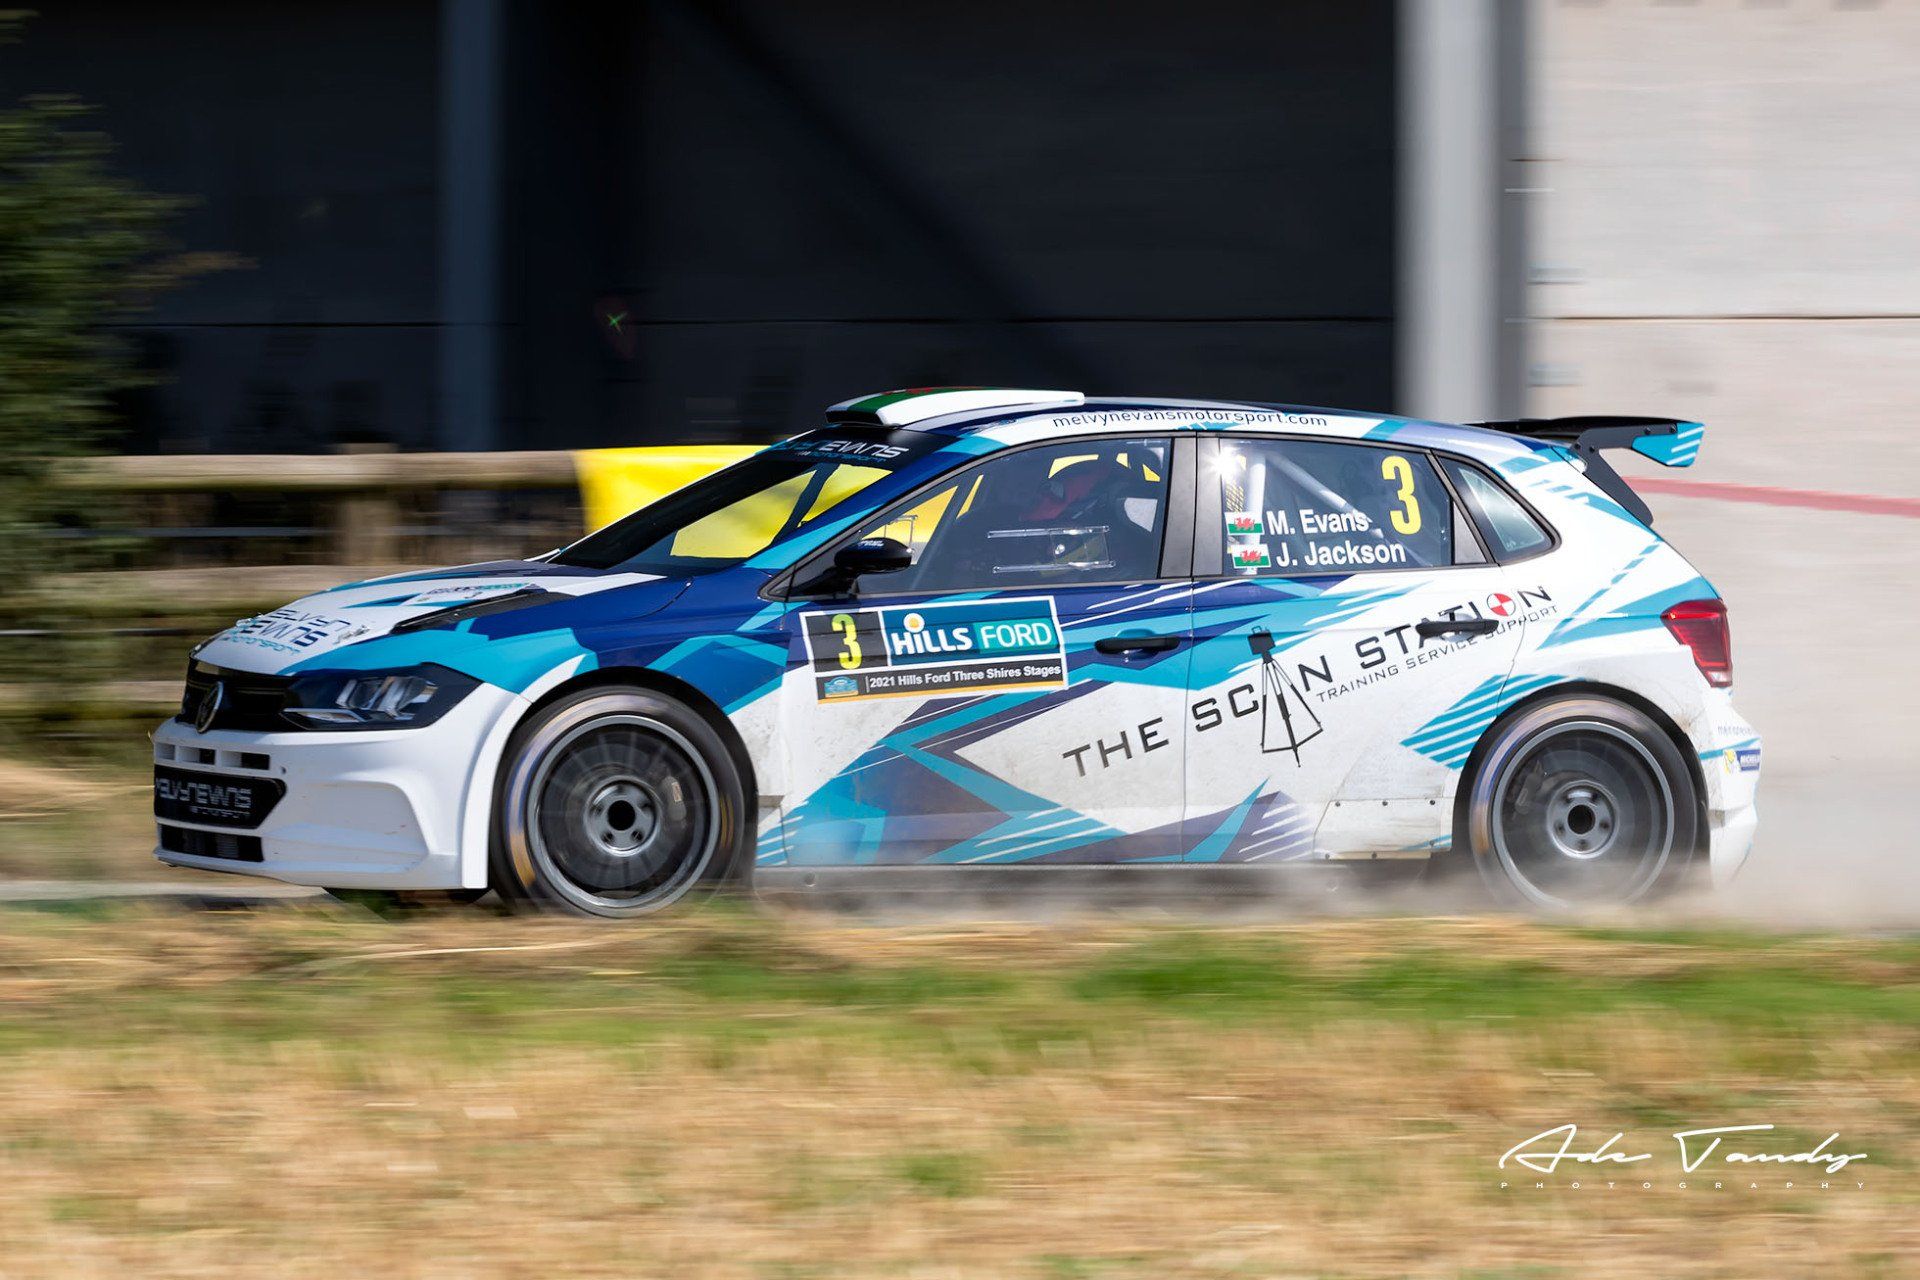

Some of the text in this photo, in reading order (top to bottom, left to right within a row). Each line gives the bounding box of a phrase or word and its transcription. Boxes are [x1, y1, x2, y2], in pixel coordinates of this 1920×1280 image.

[1053, 410, 1328, 427] melvynevansmotorsport.com
[1381, 455, 1422, 535] 3
[1266, 508, 1371, 535] M. Evans
[1276, 540, 1407, 568] J. Jackson
[831, 613, 863, 670] 3
[980, 622, 1052, 649] FORD
[1316, 605, 1559, 703] TRAINING SERVICE SUPPORT
[869, 675, 896, 688] 2021
[898, 674, 923, 686] Hills
[925, 672, 951, 684] Ford
[953, 670, 984, 682] Three
[986, 667, 1021, 680] Shires
[1023, 664, 1062, 679] Stages
[1062, 717, 1169, 777] THE
